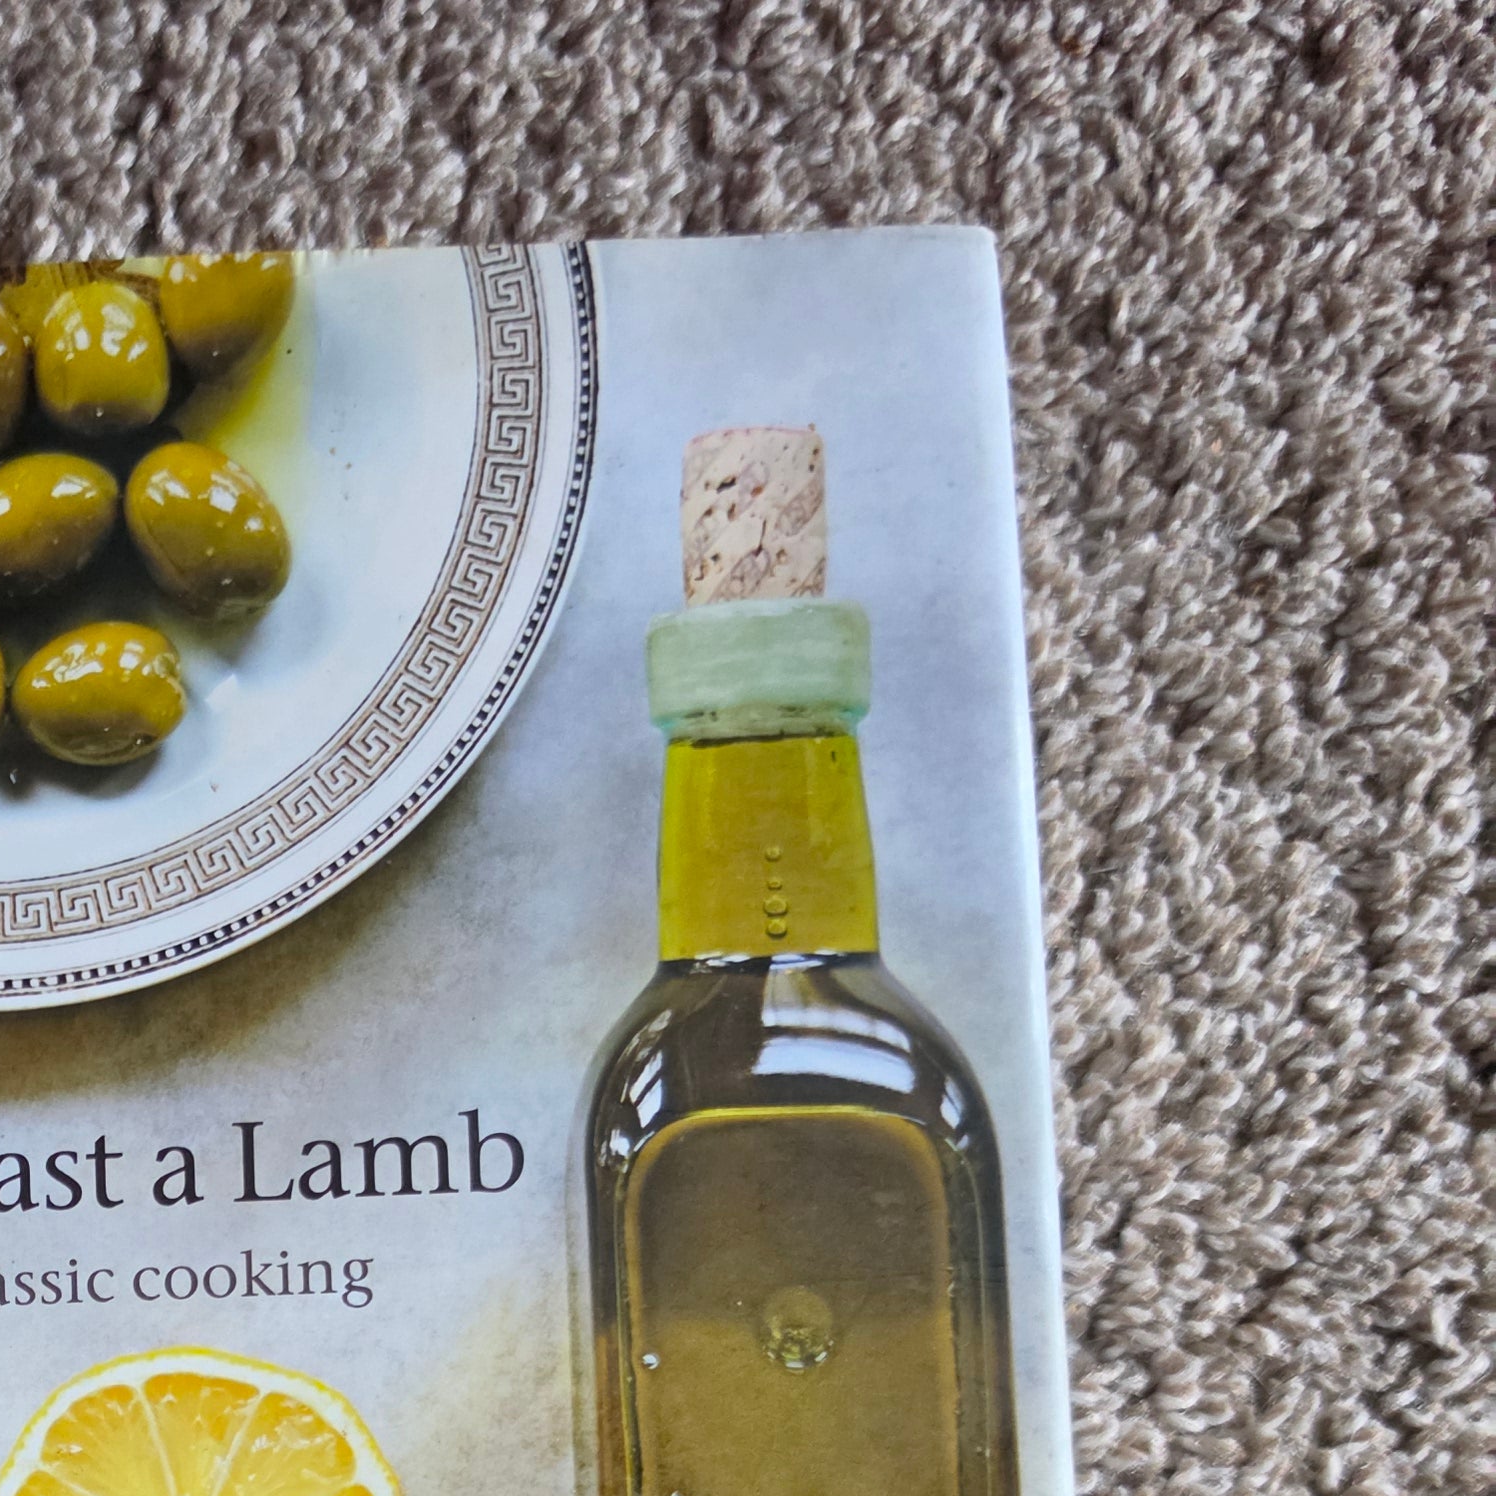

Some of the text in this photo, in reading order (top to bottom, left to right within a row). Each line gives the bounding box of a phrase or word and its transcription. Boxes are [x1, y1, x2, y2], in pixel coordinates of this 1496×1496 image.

[151, 1148, 204, 1204] a
[232, 1110, 526, 1202] Lamb
[132, 1248, 376, 1309] cooking
